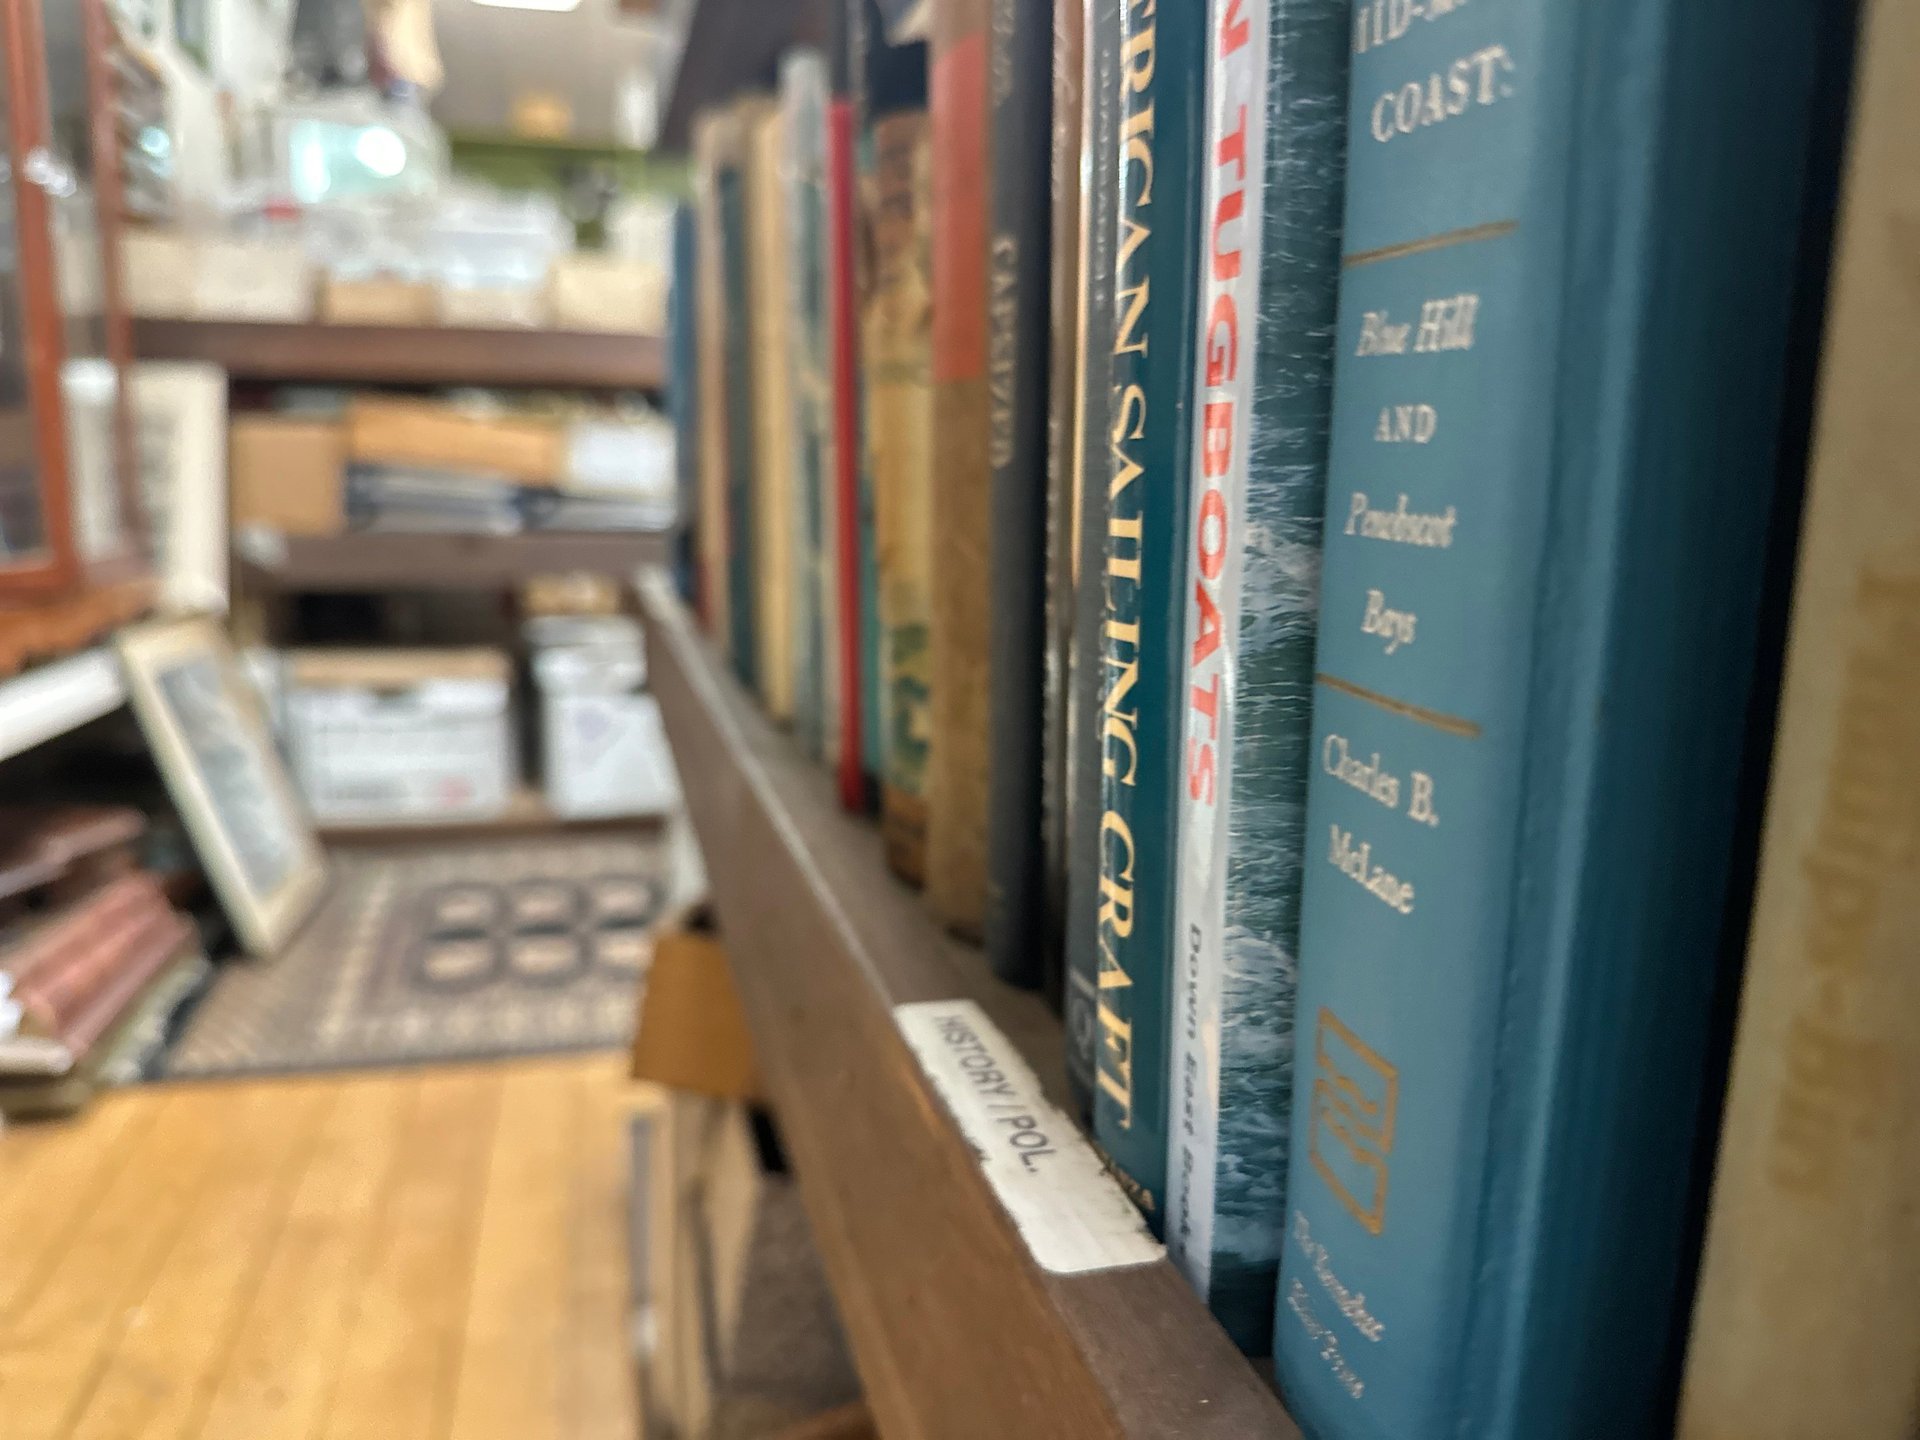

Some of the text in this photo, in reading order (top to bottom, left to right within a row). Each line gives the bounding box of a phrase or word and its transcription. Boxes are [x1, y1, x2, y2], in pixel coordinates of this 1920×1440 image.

[1413, 293, 1479, 353] Hill
[1187, 103, 1248, 806] TUGBOATS
[1374, 404, 1437, 444] AND
[1101, 383, 1148, 787] SAILING
[1361, 588, 1418, 655] Bays
[1323, 734, 1439, 828] Charles B.
[1328, 824, 1414, 914] McLane
[1097, 810, 1134, 1130] CRAFT
[1186, 922, 1202, 1040] Down
[933, 1014, 1017, 1097] HISTORY
[1182, 1051, 1199, 1137] East
